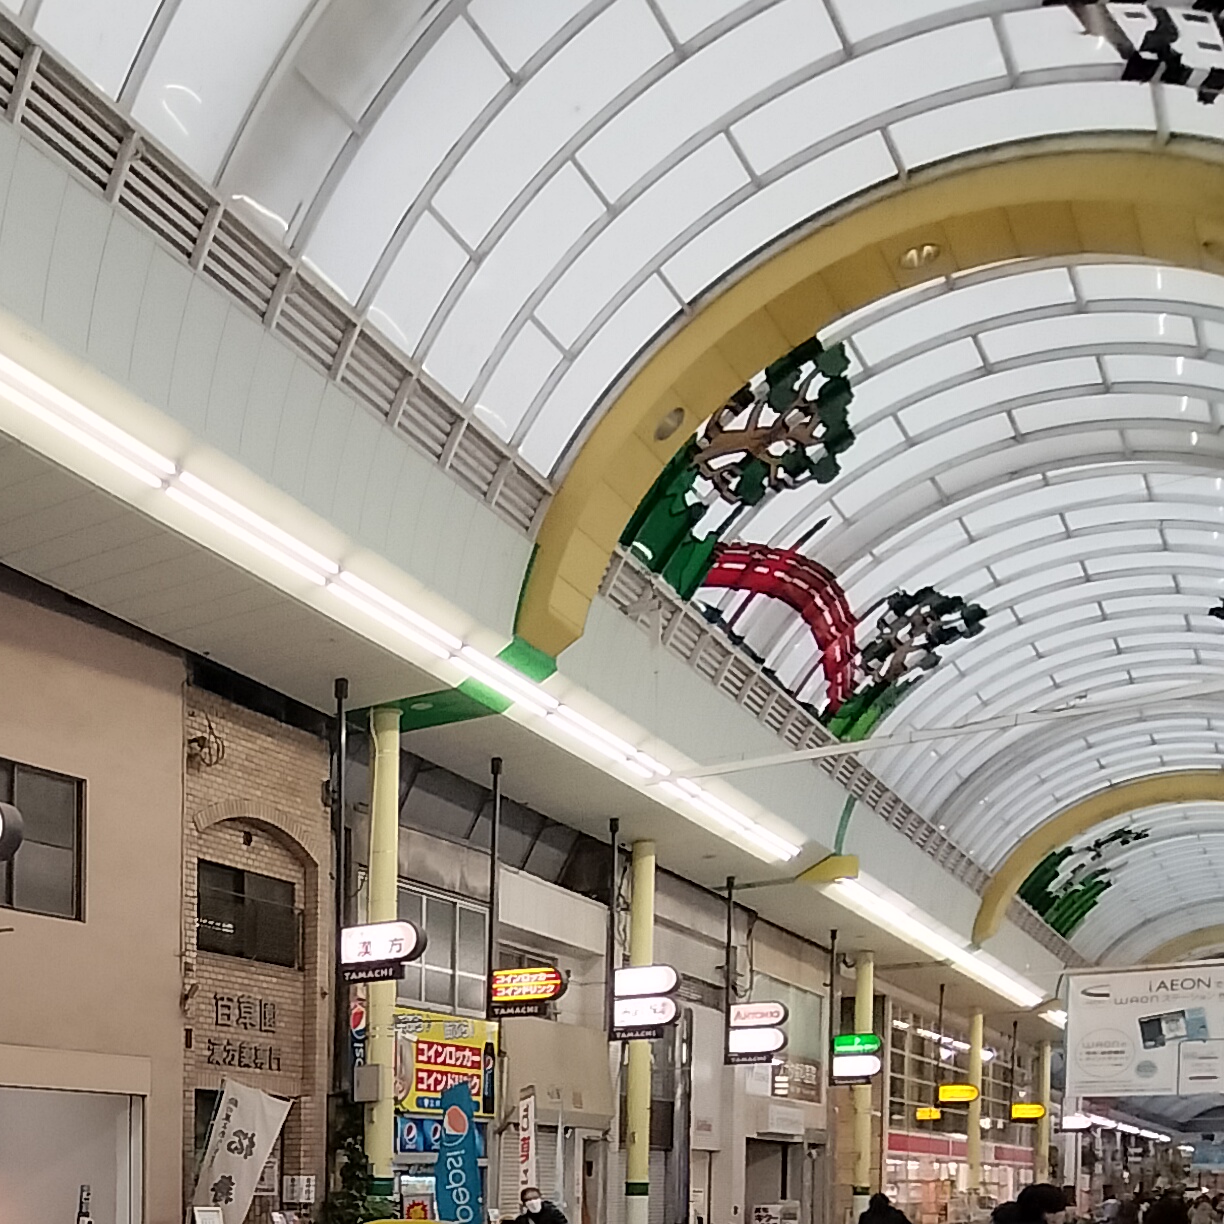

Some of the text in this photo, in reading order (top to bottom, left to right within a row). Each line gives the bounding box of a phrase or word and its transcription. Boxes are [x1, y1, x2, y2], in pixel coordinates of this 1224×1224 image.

[344, 967, 393, 980] TAMACHI
[496, 973, 556, 984] コインロッカー
[496, 984, 555, 996] コインドリンク
[493, 1006, 538, 1015] TAMACHI
[616, 1030, 656, 1039] TAMACHI
[417, 1042, 481, 1068] コインロッカー
